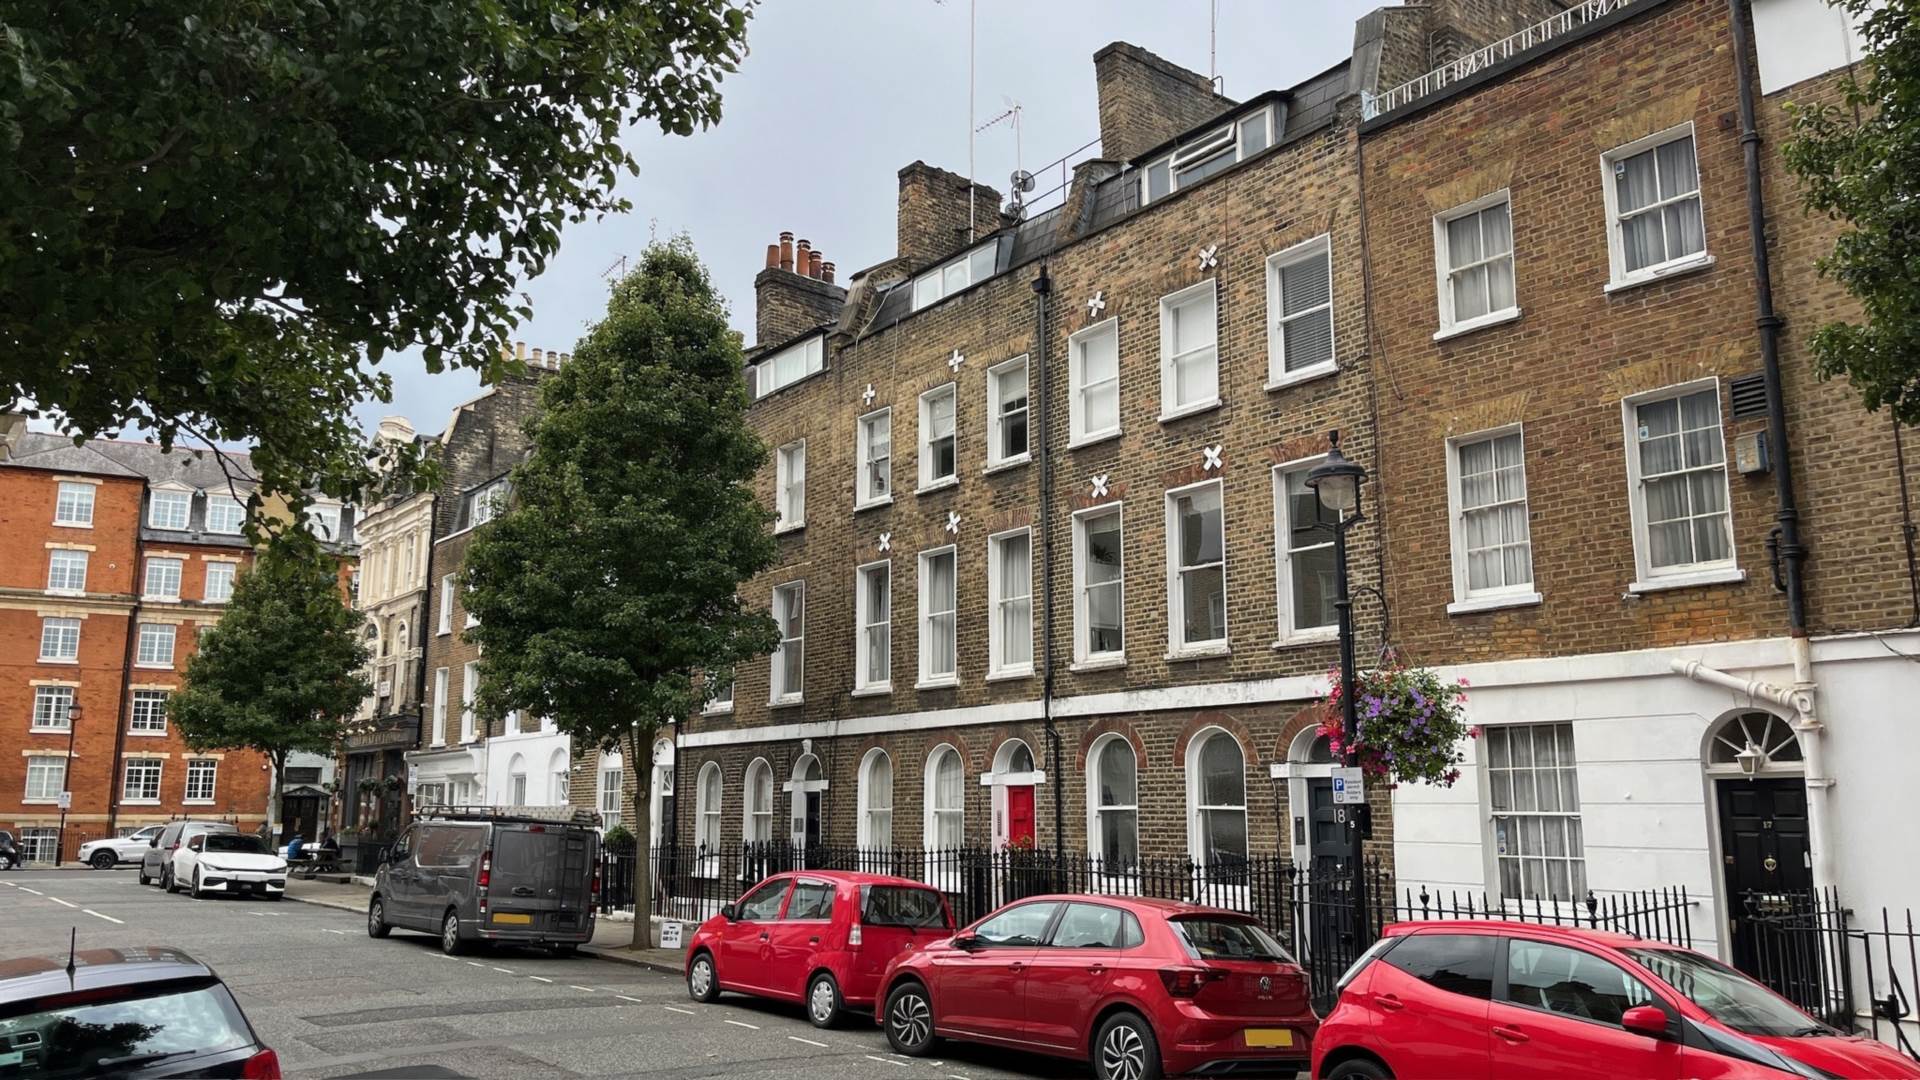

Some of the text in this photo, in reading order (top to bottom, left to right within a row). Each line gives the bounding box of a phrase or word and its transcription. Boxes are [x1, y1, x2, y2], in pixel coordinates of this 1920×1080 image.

[1336, 779, 1343, 790] P
[1333, 808, 1346, 824] 18
[1350, 820, 1355, 828] 5
[1763, 820, 1773, 829] 17
